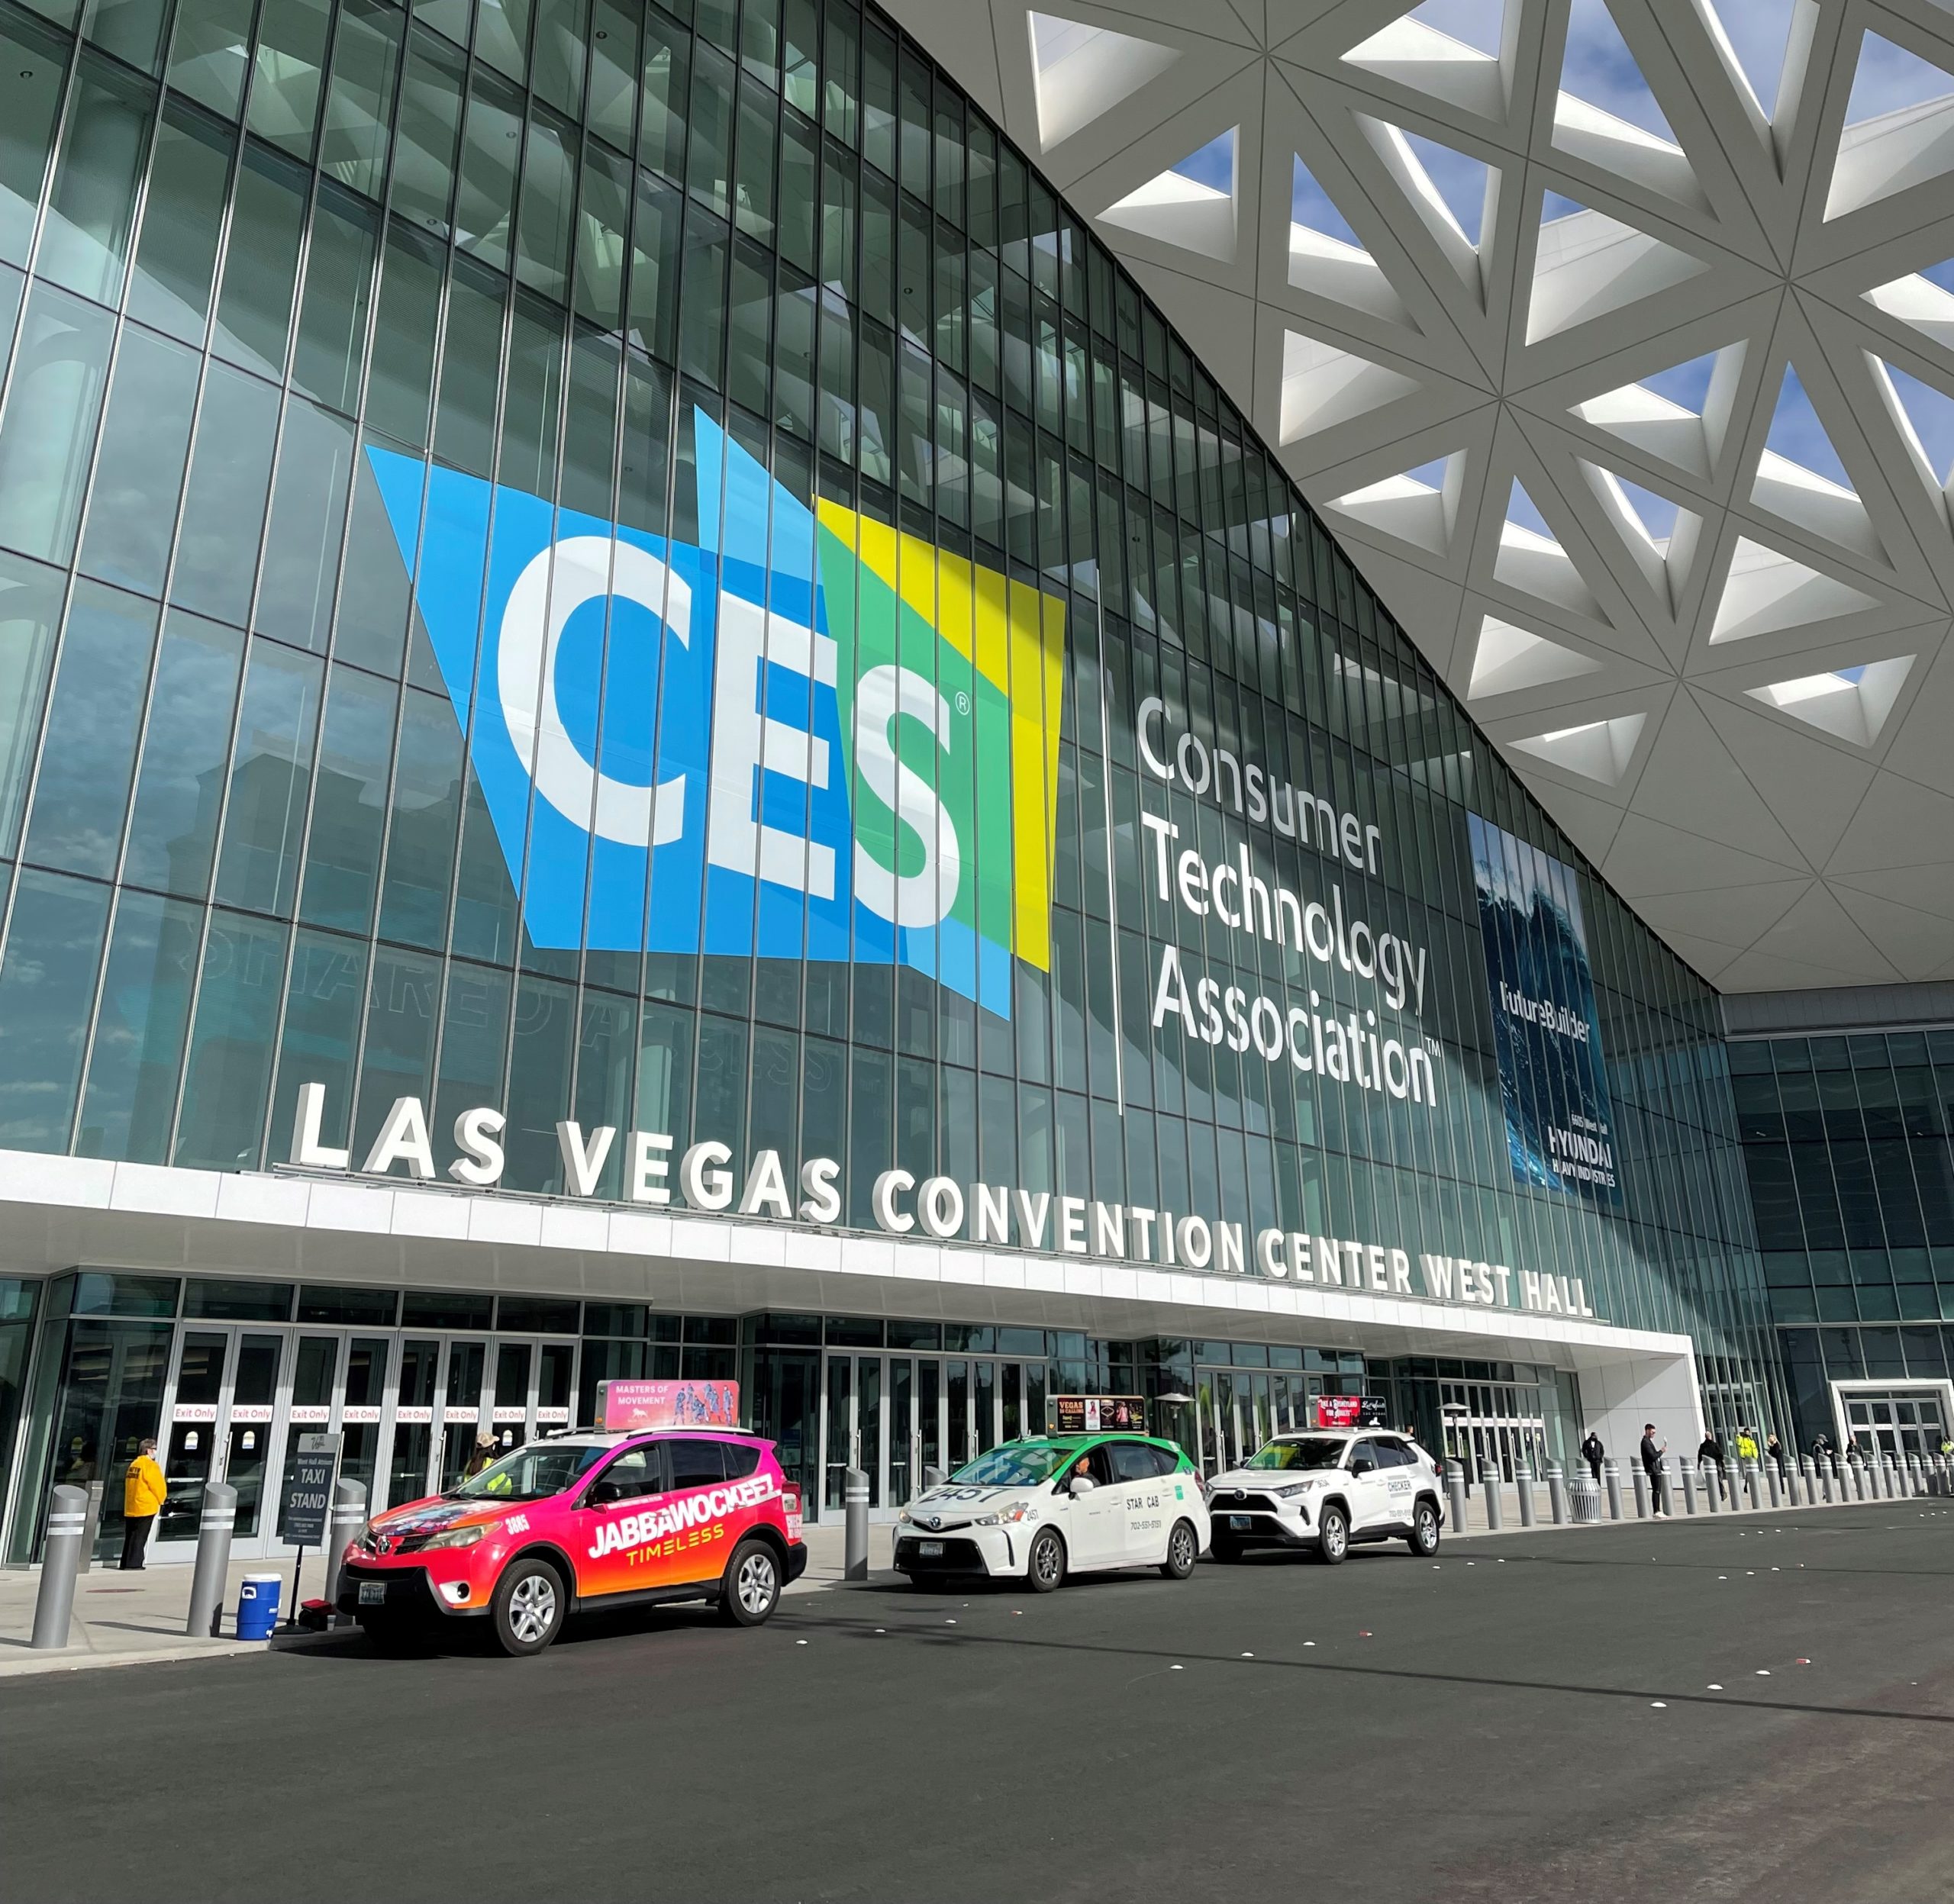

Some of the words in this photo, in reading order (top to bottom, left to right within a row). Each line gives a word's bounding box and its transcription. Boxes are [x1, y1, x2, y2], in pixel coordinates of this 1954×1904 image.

[1137, 697, 1380, 875] Consumer
[1142, 811, 1426, 1016] Technology
[1499, 981, 1590, 1043] FutureBuilder
[1548, 1126, 1613, 1169] HYUNDAI
[1552, 1158, 1576, 1177] HAVY
[1577, 1165, 1615, 1187] INDSTRES
[289, 1082, 506, 1185] LAS
[556, 1120, 840, 1223] VEGAS
[872, 1169, 1245, 1273] CONVENTION
[1257, 1228, 1412, 1294] CENTER
[1419, 1253, 1510, 1306] WEST
[1518, 1270, 1592, 1317] HALL
[616, 1385, 656, 1394] MASTERS
[657, 1385, 669, 1393] OF
[617, 1397, 666, 1405] MOVEMENT
[176, 1409, 193, 1417] Exit
[195, 1409, 215, 1419] Only
[232, 1409, 250, 1418] Exit
[251, 1409, 271, 1419] Only
[292, 1410, 307, 1419] Exit
[309, 1410, 328, 1419] Only
[344, 1410, 360, 1419] Exit
[361, 1410, 379, 1419] Only
[398, 1410, 411, 1419] Exit
[413, 1411, 430, 1420] Only
[461, 1411, 477, 1420] Only
[509, 1411, 524, 1420] Only
[553, 1411, 567, 1420] Only
[301, 1468, 326, 1484] TAXI
[1388, 1480, 1411, 1492] CHECKER
[289, 1492, 326, 1509] STAND
[919, 1487, 1011, 1503] 2457
[1126, 1497, 1143, 1510] STAR
[1146, 1496, 1159, 1508] CAB
[588, 1473, 782, 1559] JABBAWOCKEEZ
[1026, 1509, 1039, 1521] 2457
[505, 1514, 530, 1535] 3885
[626, 1523, 724, 1566] TIMELESS
